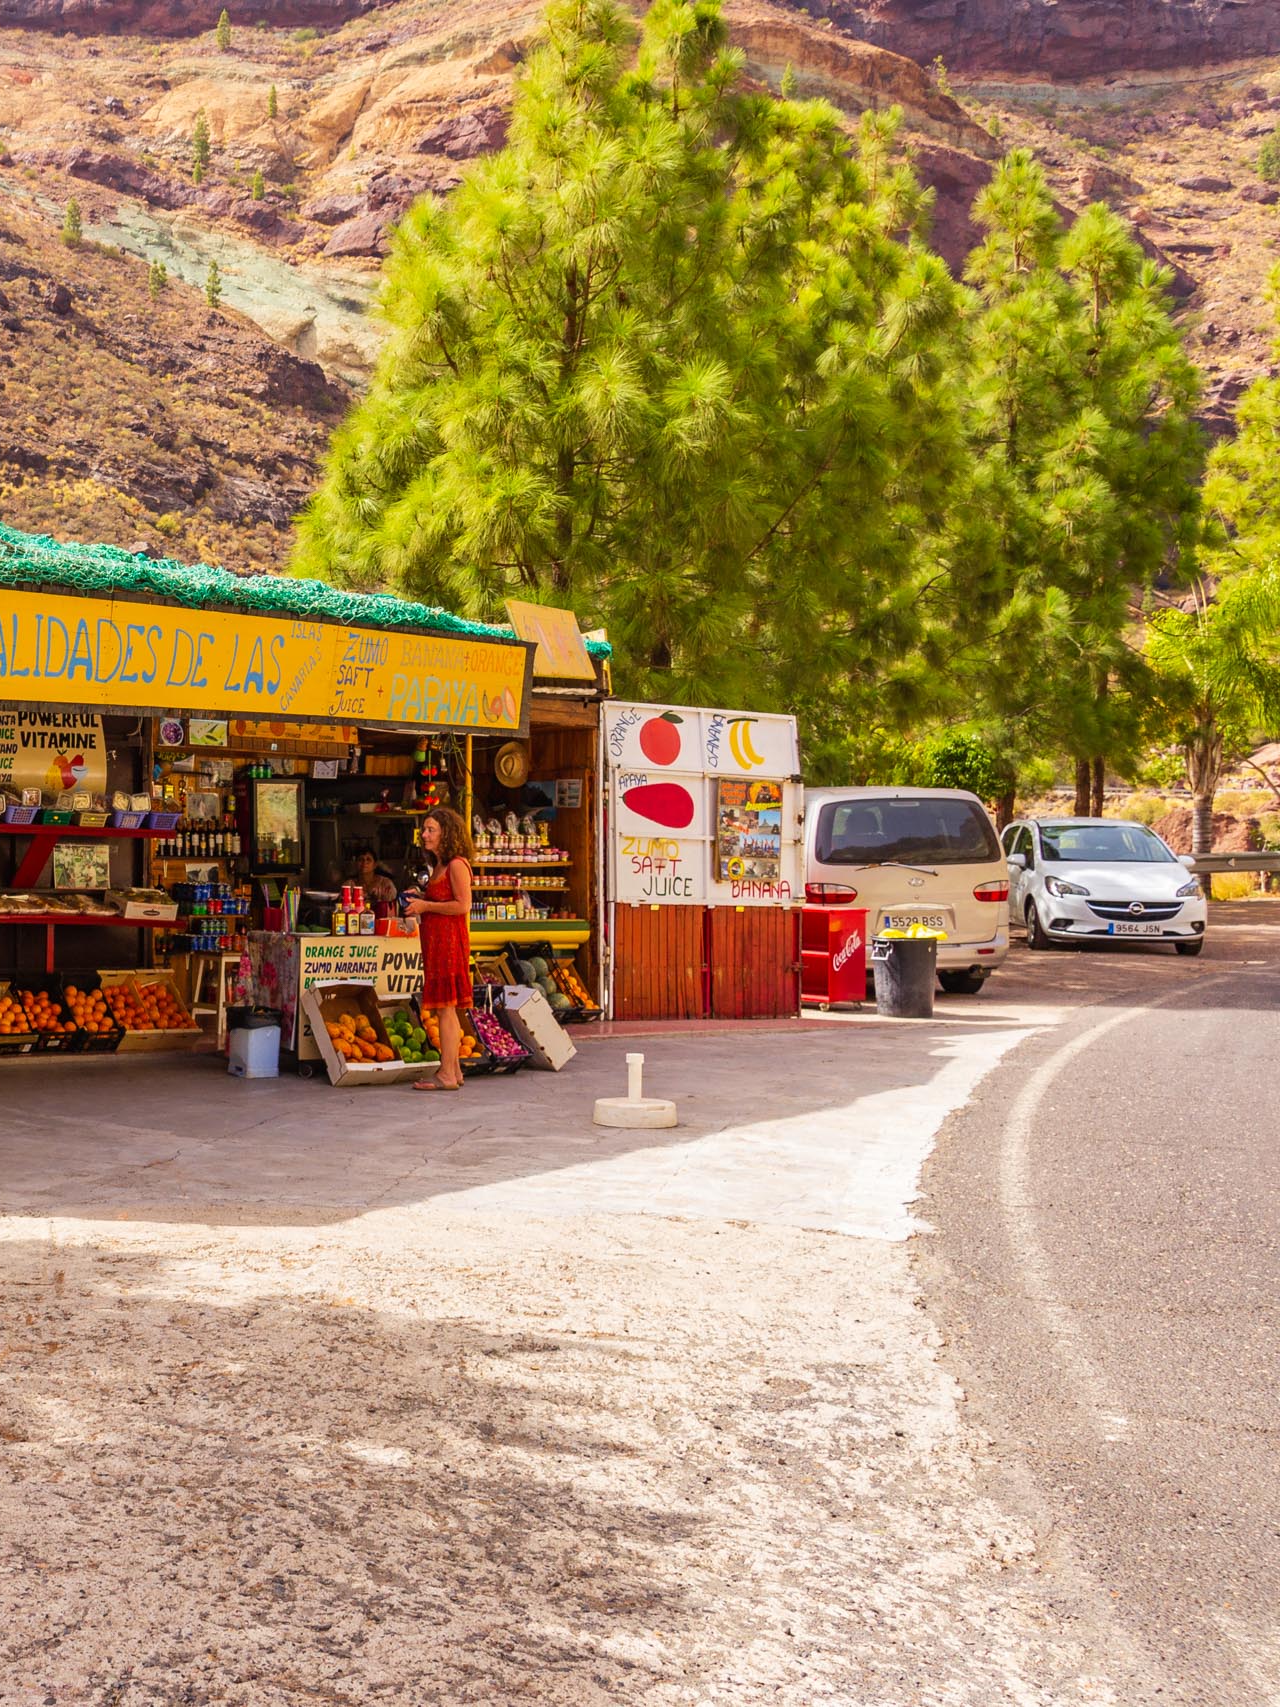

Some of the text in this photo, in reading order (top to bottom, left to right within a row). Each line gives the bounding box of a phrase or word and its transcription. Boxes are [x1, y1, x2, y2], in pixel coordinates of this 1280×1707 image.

[290, 622, 323, 642] ISLAS
[166, 628, 215, 688] DE
[224, 633, 285, 695] LAS
[342, 632, 389, 667] ZUMO
[400, 639, 463, 671] BANANA
[471, 649, 521, 676] ORANGE
[280, 646, 323, 711] CANARIAS
[336, 664, 374, 689] SAFT
[329, 690, 365, 715] JUICE
[387, 674, 479, 724] PAPAYA
[18, 711, 99, 728] POWERFUL
[21, 731, 96, 749] VITAMINE
[621, 837, 680, 859] ZUMO
[631, 856, 682, 877] SAFT
[731, 880, 791, 899] BANANA
[892, 916, 943, 927] 5529 BSS
[1116, 924, 1161, 933] 9564 JSN
[305, 945, 379, 958] ORANGE JUICE
[304, 961, 378, 974] ZUMO NARANJA
